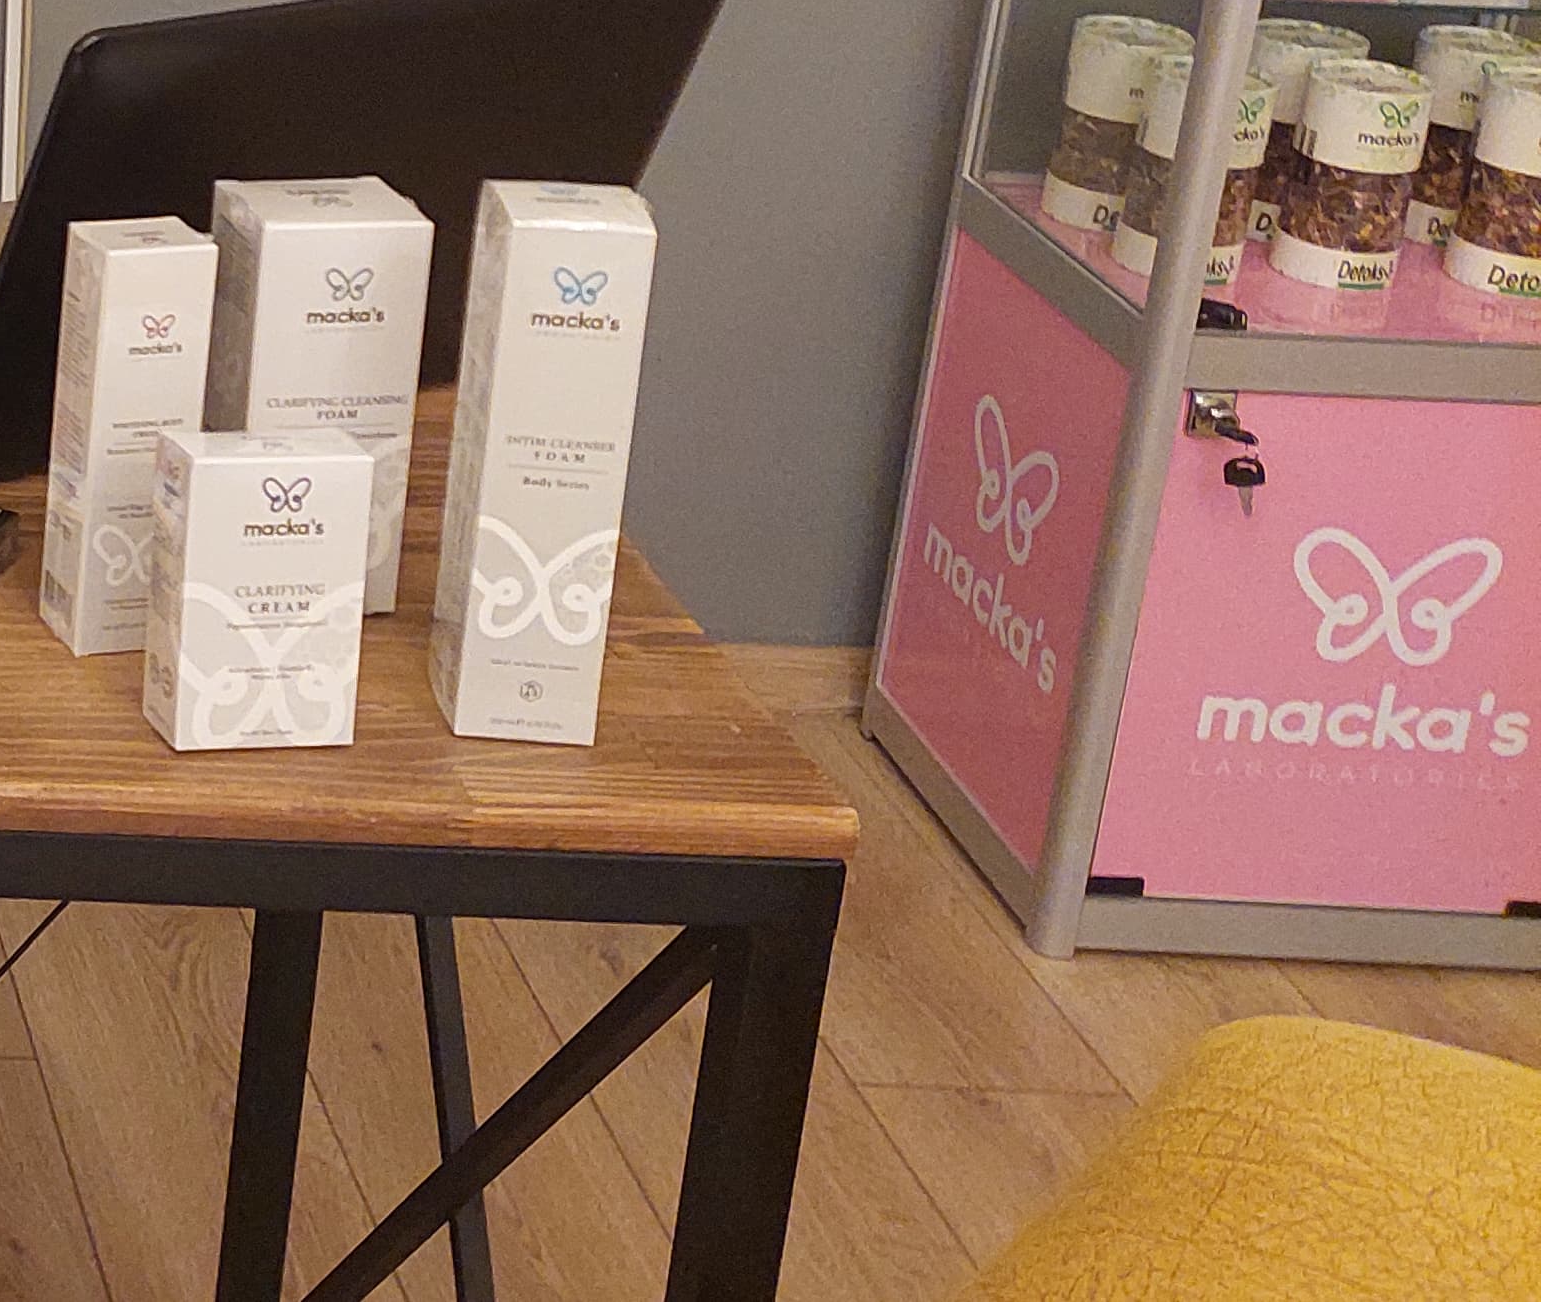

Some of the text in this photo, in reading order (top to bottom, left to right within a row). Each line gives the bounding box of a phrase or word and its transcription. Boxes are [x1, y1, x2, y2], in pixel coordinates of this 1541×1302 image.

[306, 306, 386, 325] macka's
[530, 310, 621, 332] macka's
[316, 409, 359, 421] FOAM
[533, 450, 587, 465] FOAM
[242, 517, 325, 538] macka's
[234, 583, 326, 599] CLARIFYING
[247, 601, 311, 615] CREAM
[922, 521, 1057, 695] macka's
[1196, 681, 1532, 758] macka's
